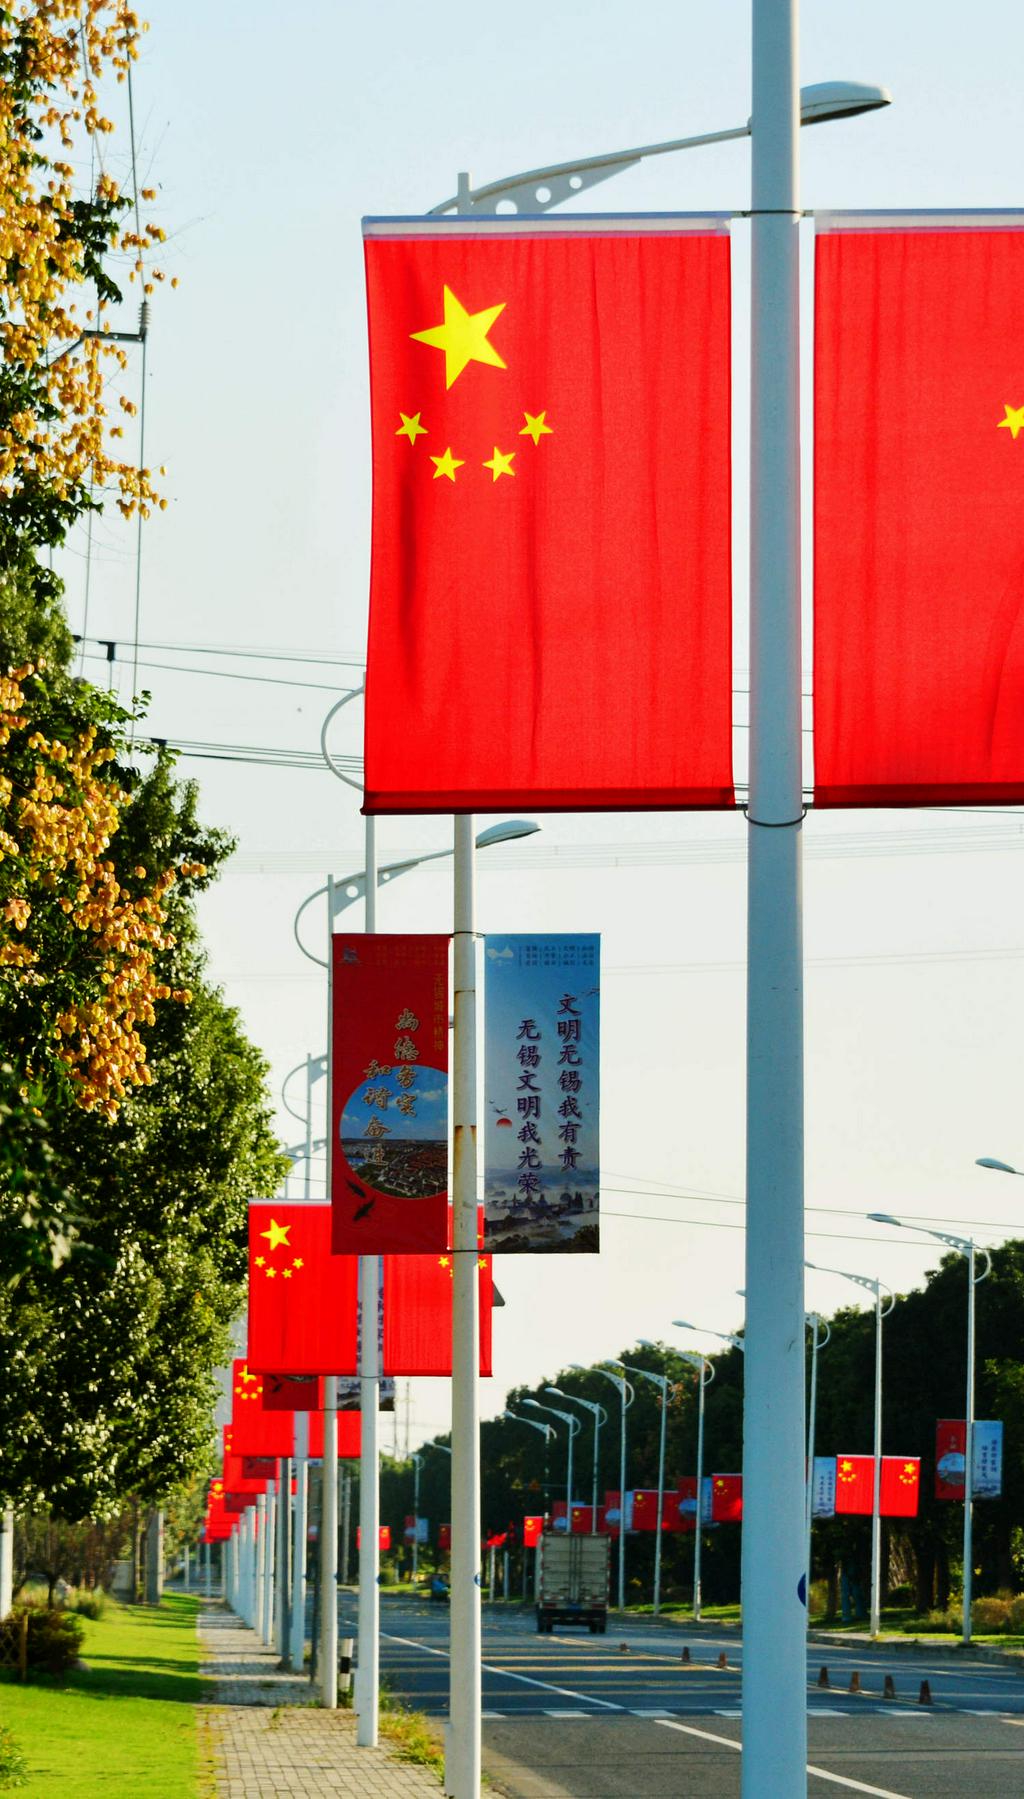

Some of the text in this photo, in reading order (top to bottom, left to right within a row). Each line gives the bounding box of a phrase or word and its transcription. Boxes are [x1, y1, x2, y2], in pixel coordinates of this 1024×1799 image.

[516, 1019, 542, 1194] 无锡文明我光荣
[557, 993, 582, 1171] 文明无锡我有责
